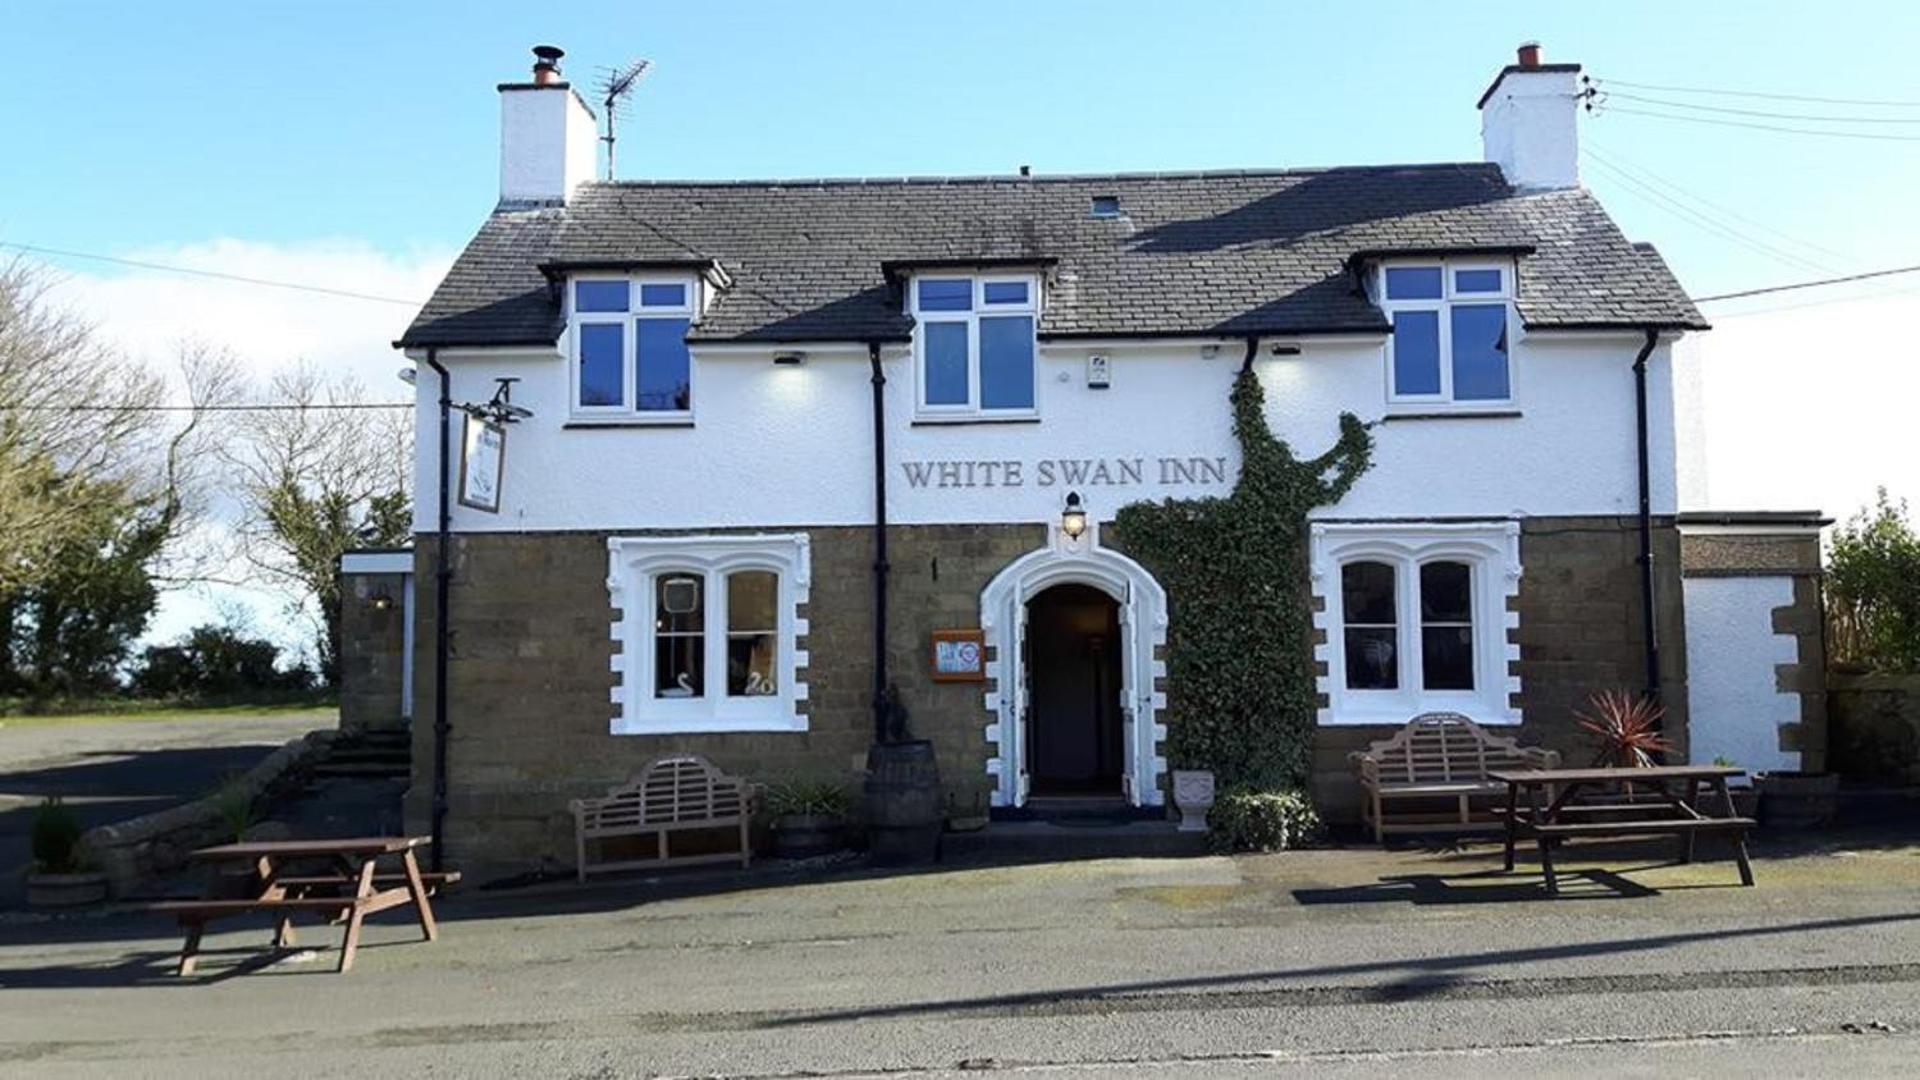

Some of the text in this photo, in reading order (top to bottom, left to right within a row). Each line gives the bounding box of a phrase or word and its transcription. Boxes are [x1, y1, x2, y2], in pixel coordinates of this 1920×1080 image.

[901, 457, 1226, 487] WHITE SWAN INN
